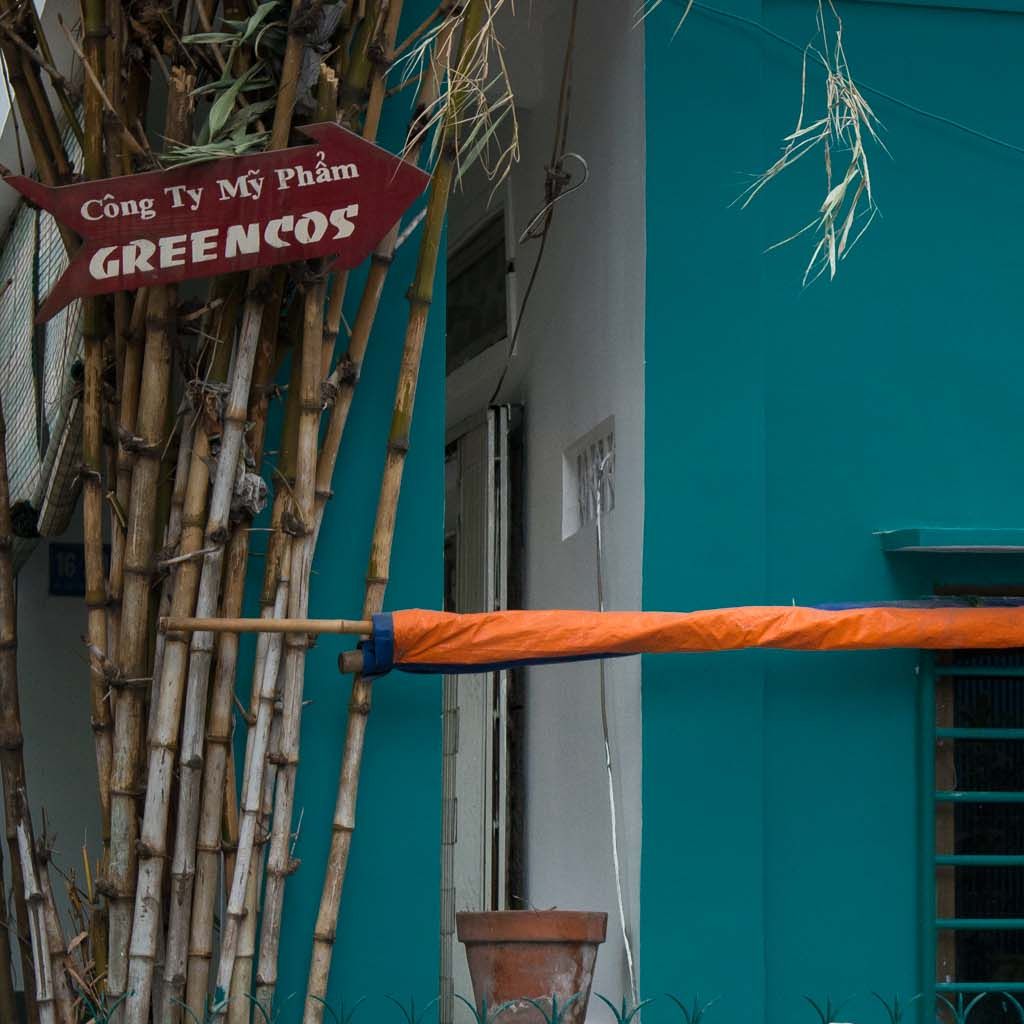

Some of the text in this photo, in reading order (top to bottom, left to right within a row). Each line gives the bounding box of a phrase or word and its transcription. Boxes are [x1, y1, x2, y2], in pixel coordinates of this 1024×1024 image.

[80, 150, 360, 221] Công Ty Mỹ Phẩm
[89, 203, 360, 280] GREENCOS
